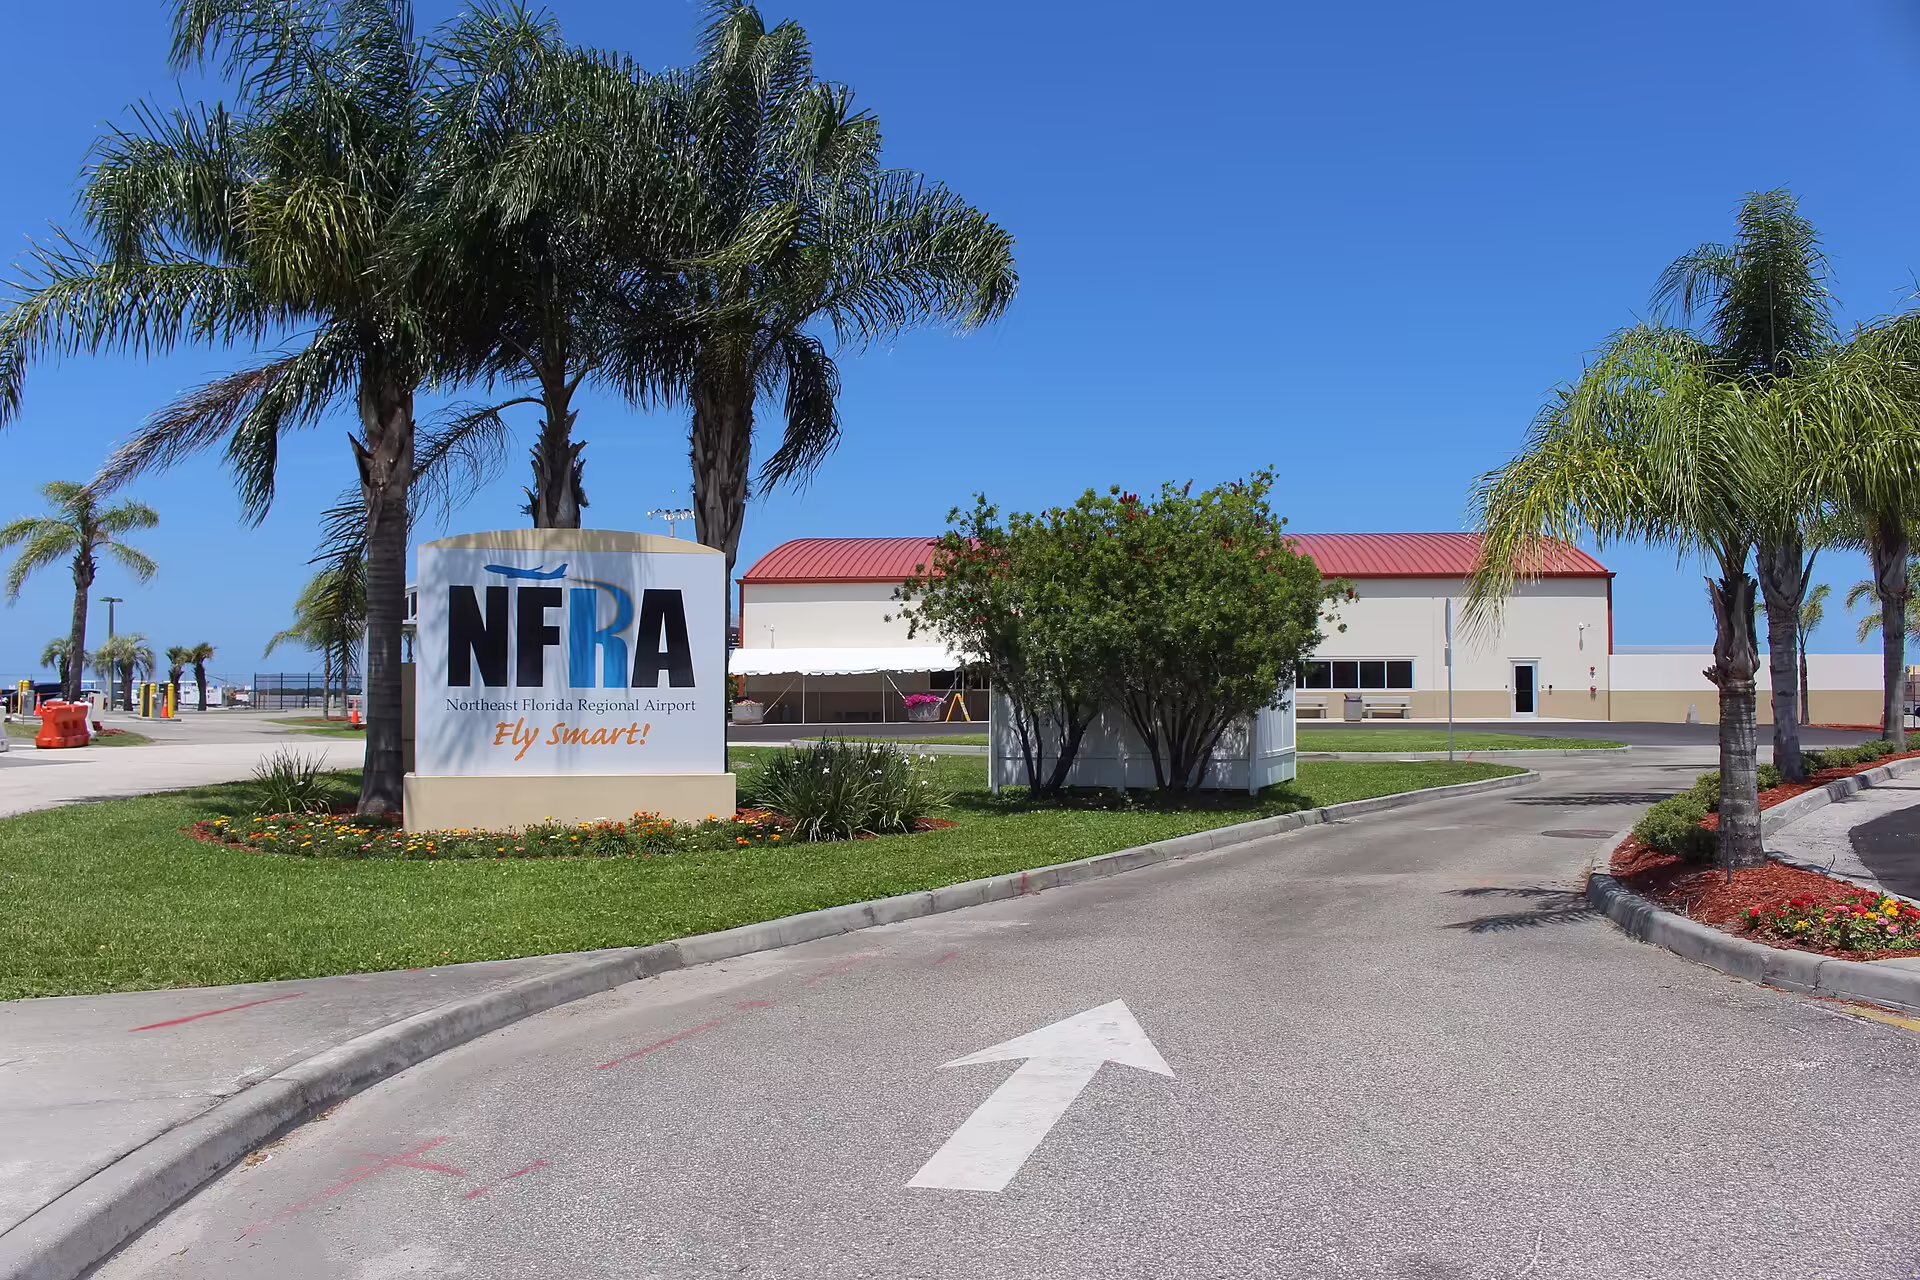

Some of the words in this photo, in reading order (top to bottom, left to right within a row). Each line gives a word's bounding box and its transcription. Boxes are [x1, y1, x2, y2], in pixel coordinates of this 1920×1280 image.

[447, 580, 696, 688] NFRA
[446, 698, 518, 711] Northeast
[522, 698, 573, 711] Florida
[577, 698, 639, 715] Regional
[644, 699, 696, 715] Airport
[493, 717, 540, 761] Fly
[546, 722, 651, 746] Smart!
